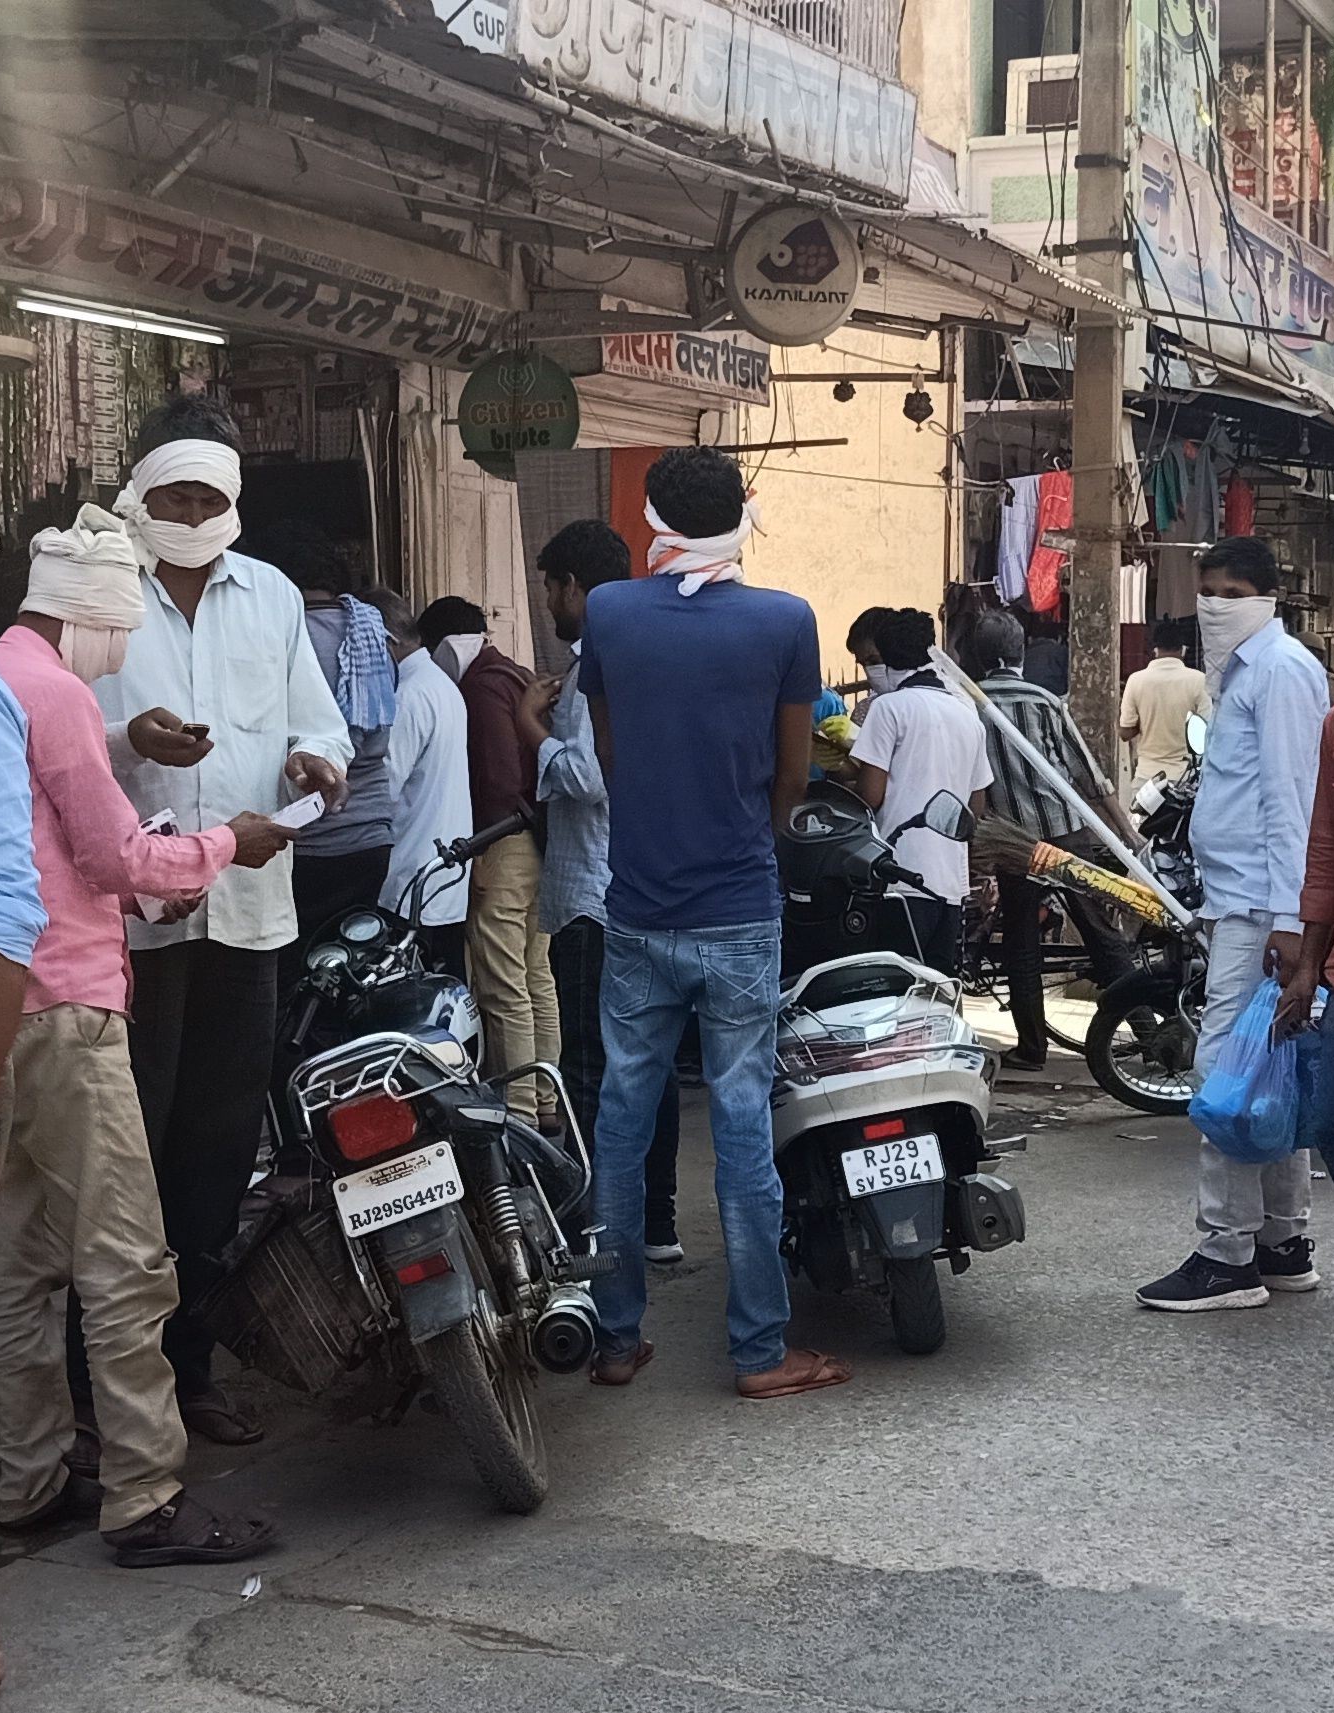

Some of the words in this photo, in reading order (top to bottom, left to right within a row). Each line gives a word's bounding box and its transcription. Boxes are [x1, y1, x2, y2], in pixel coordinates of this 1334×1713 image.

[744, 287, 849, 304] KAMILIANT
[720, 333, 769, 394] भंडार
[863, 1140, 919, 1168] RJ29
[879, 1160, 933, 1186] 5941
[348, 1180, 457, 1231] RJ29SG4473
